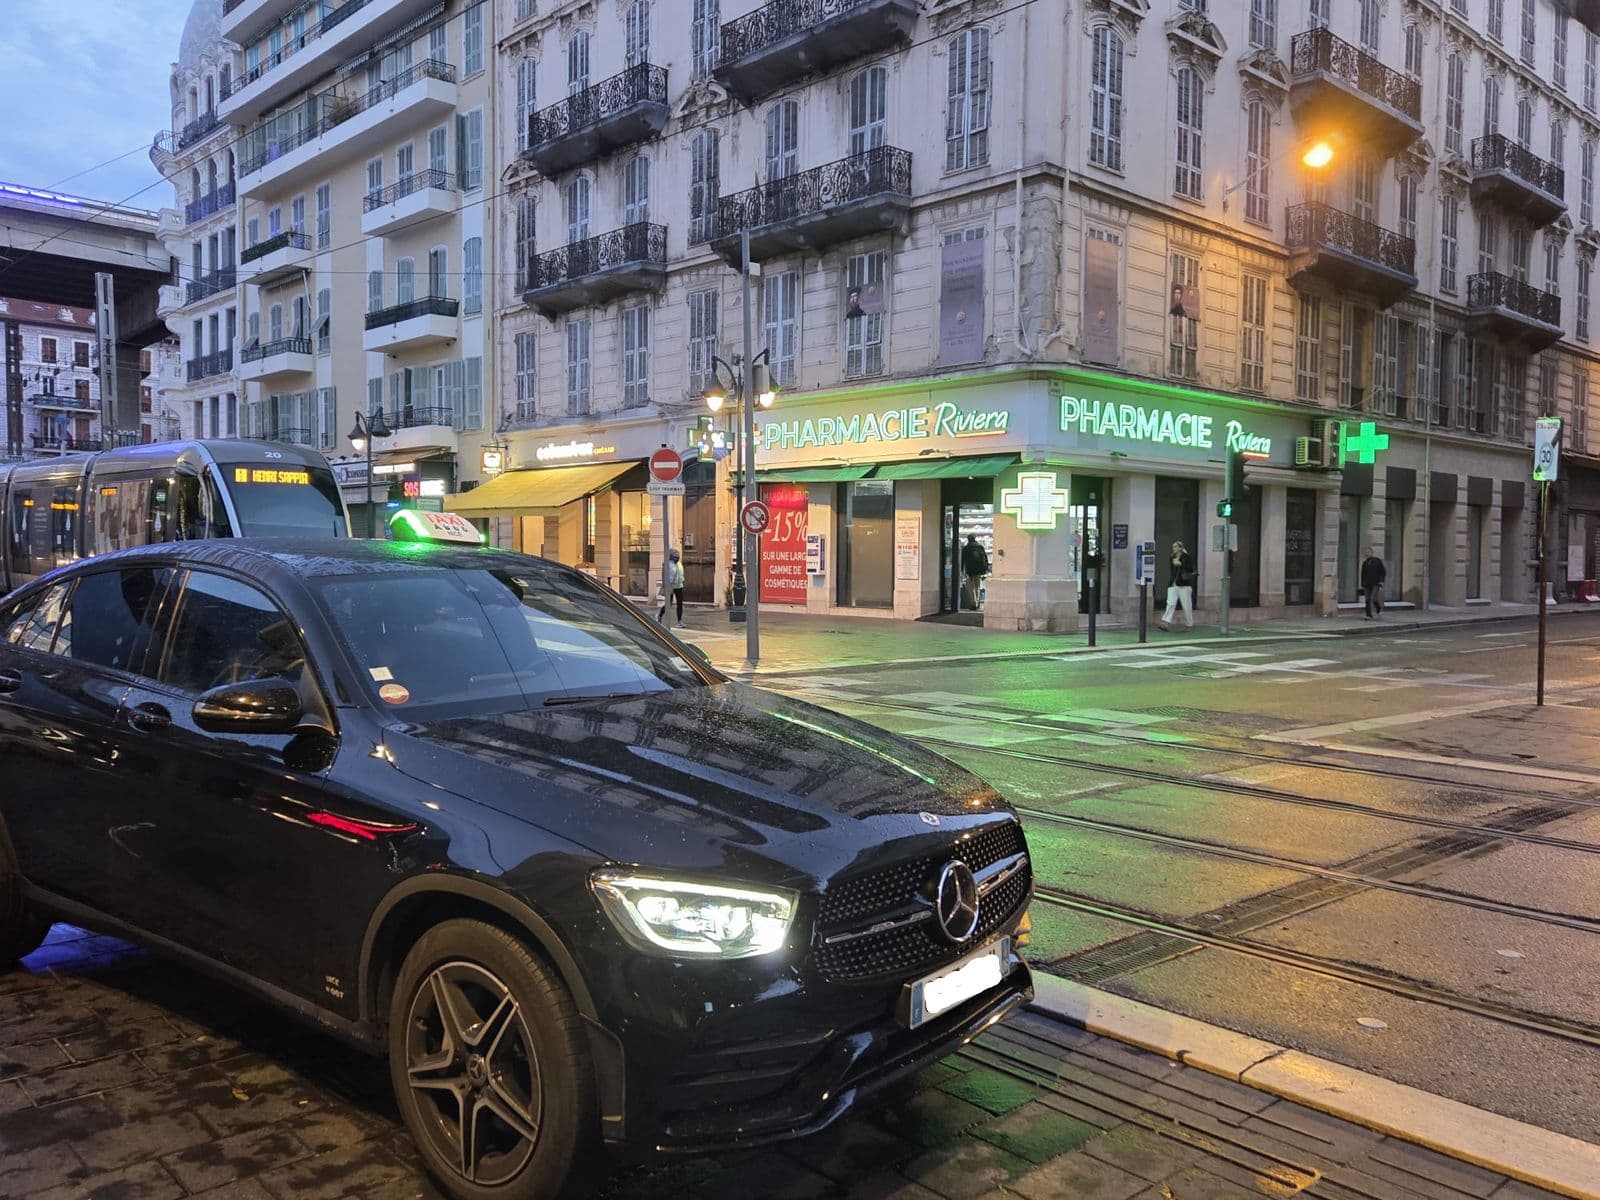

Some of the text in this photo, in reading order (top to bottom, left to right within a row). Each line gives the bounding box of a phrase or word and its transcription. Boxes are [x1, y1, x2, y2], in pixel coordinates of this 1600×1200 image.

[765, 400, 1009, 449] PHARMACIE Riviera
[1061, 396, 1272, 454] PHARMACIE Riviera
[264, 451, 282, 459] 20
[1541, 450, 1551, 463] 30
[253, 469, 277, 483] HENRI
[403, 481, 419, 498] SOS
[422, 512, 464, 527] TAXI
[763, 511, 808, 542] -15%
[763, 552, 807, 561] SUR UNE LARG
[769, 565, 801, 575] GAMME DE
